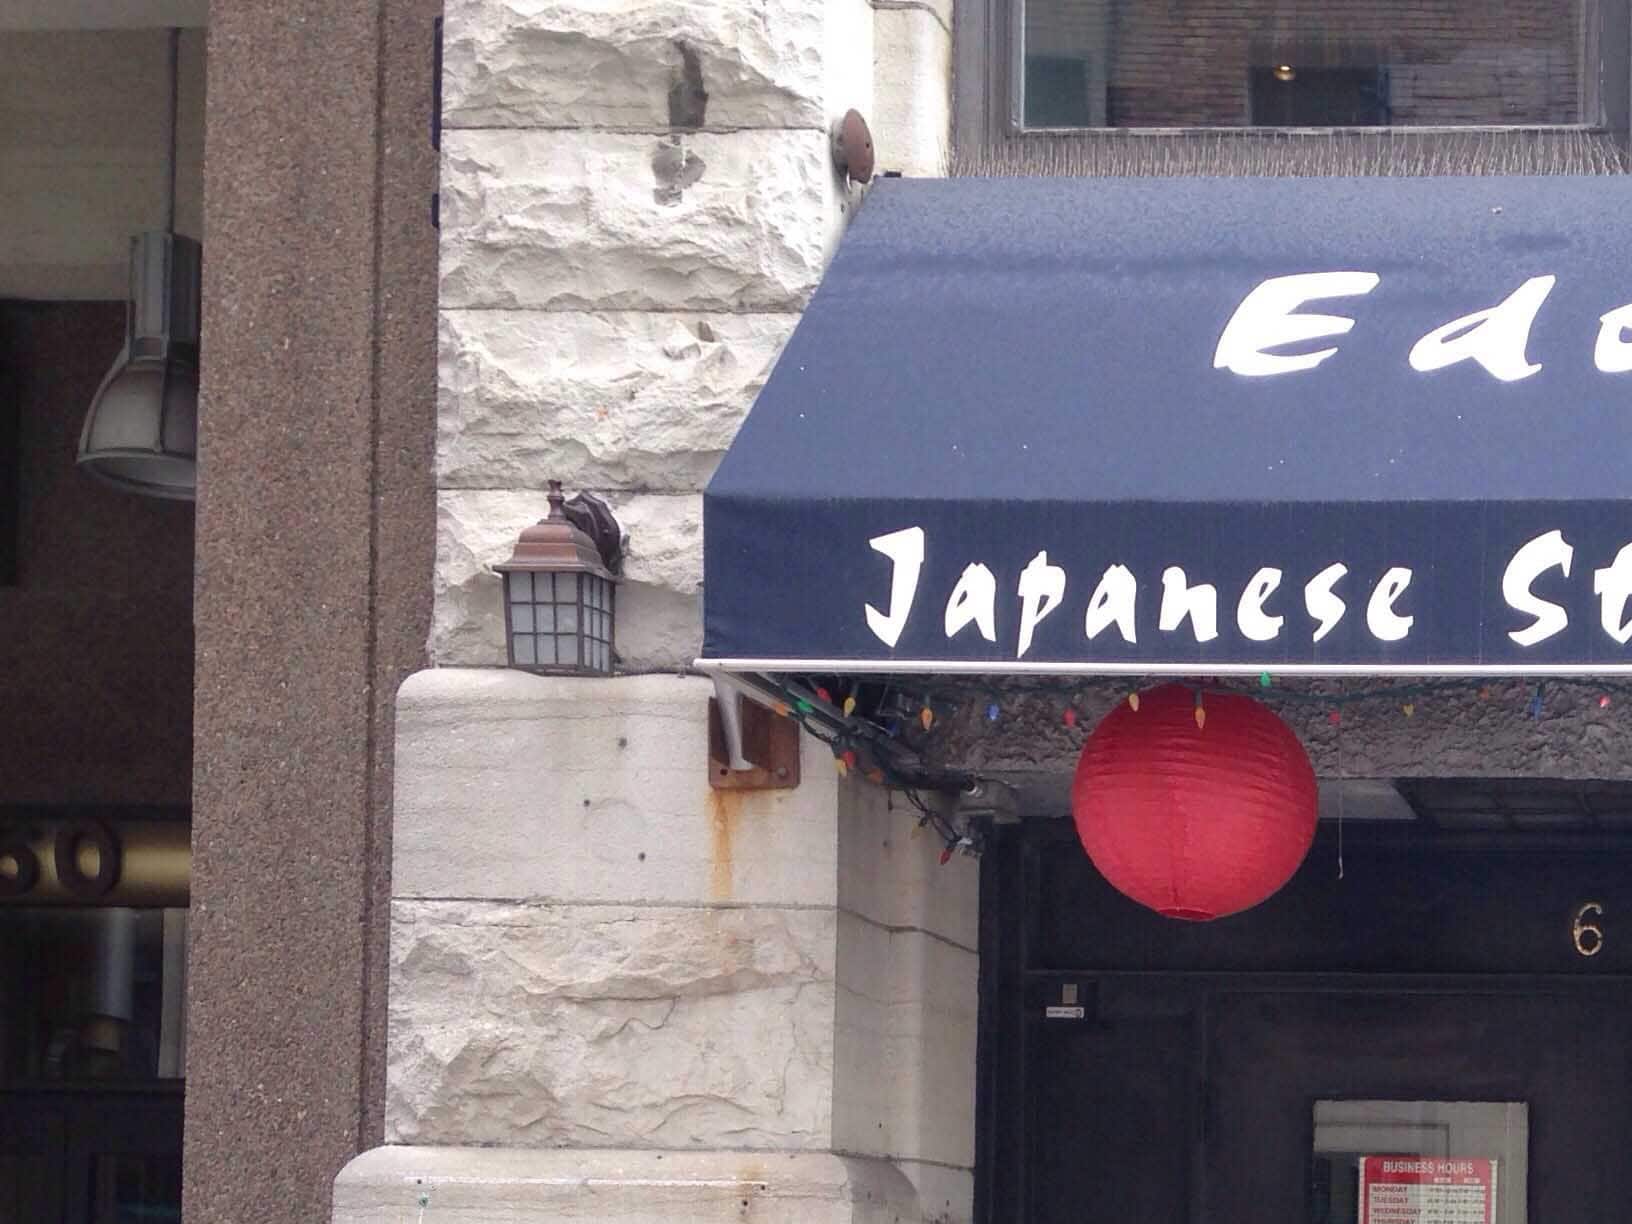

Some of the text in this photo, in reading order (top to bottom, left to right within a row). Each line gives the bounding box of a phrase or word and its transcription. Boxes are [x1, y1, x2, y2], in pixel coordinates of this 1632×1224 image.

[864, 526, 1414, 659] Japanese
[1383, 1160, 1474, 1175] BUSINESS HOURS
[1373, 1207, 1422, 1215] WEDNESDAY
